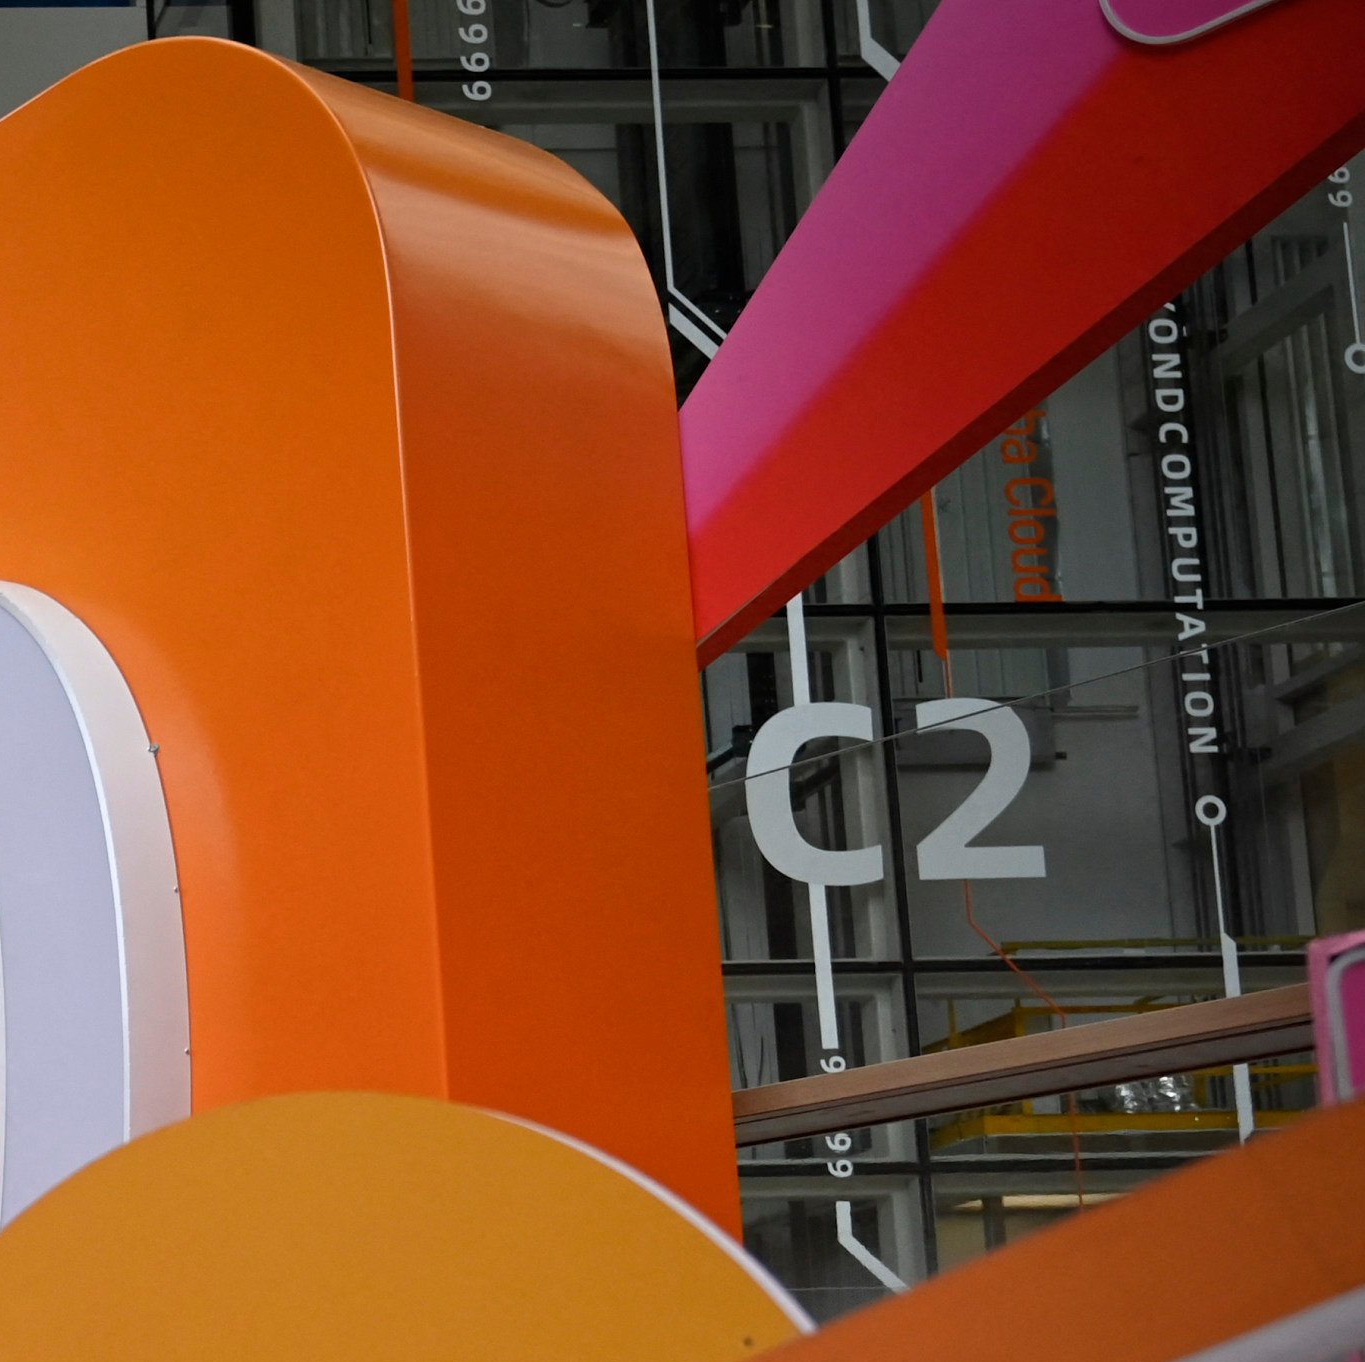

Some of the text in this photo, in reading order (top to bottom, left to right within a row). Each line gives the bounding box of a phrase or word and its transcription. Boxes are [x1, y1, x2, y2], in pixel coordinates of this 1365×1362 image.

[1004, 477, 1065, 603] Cloud
[1148, 302, 1219, 753] ONDCOMPUTATION
[745, 697, 1047, 887] C2
